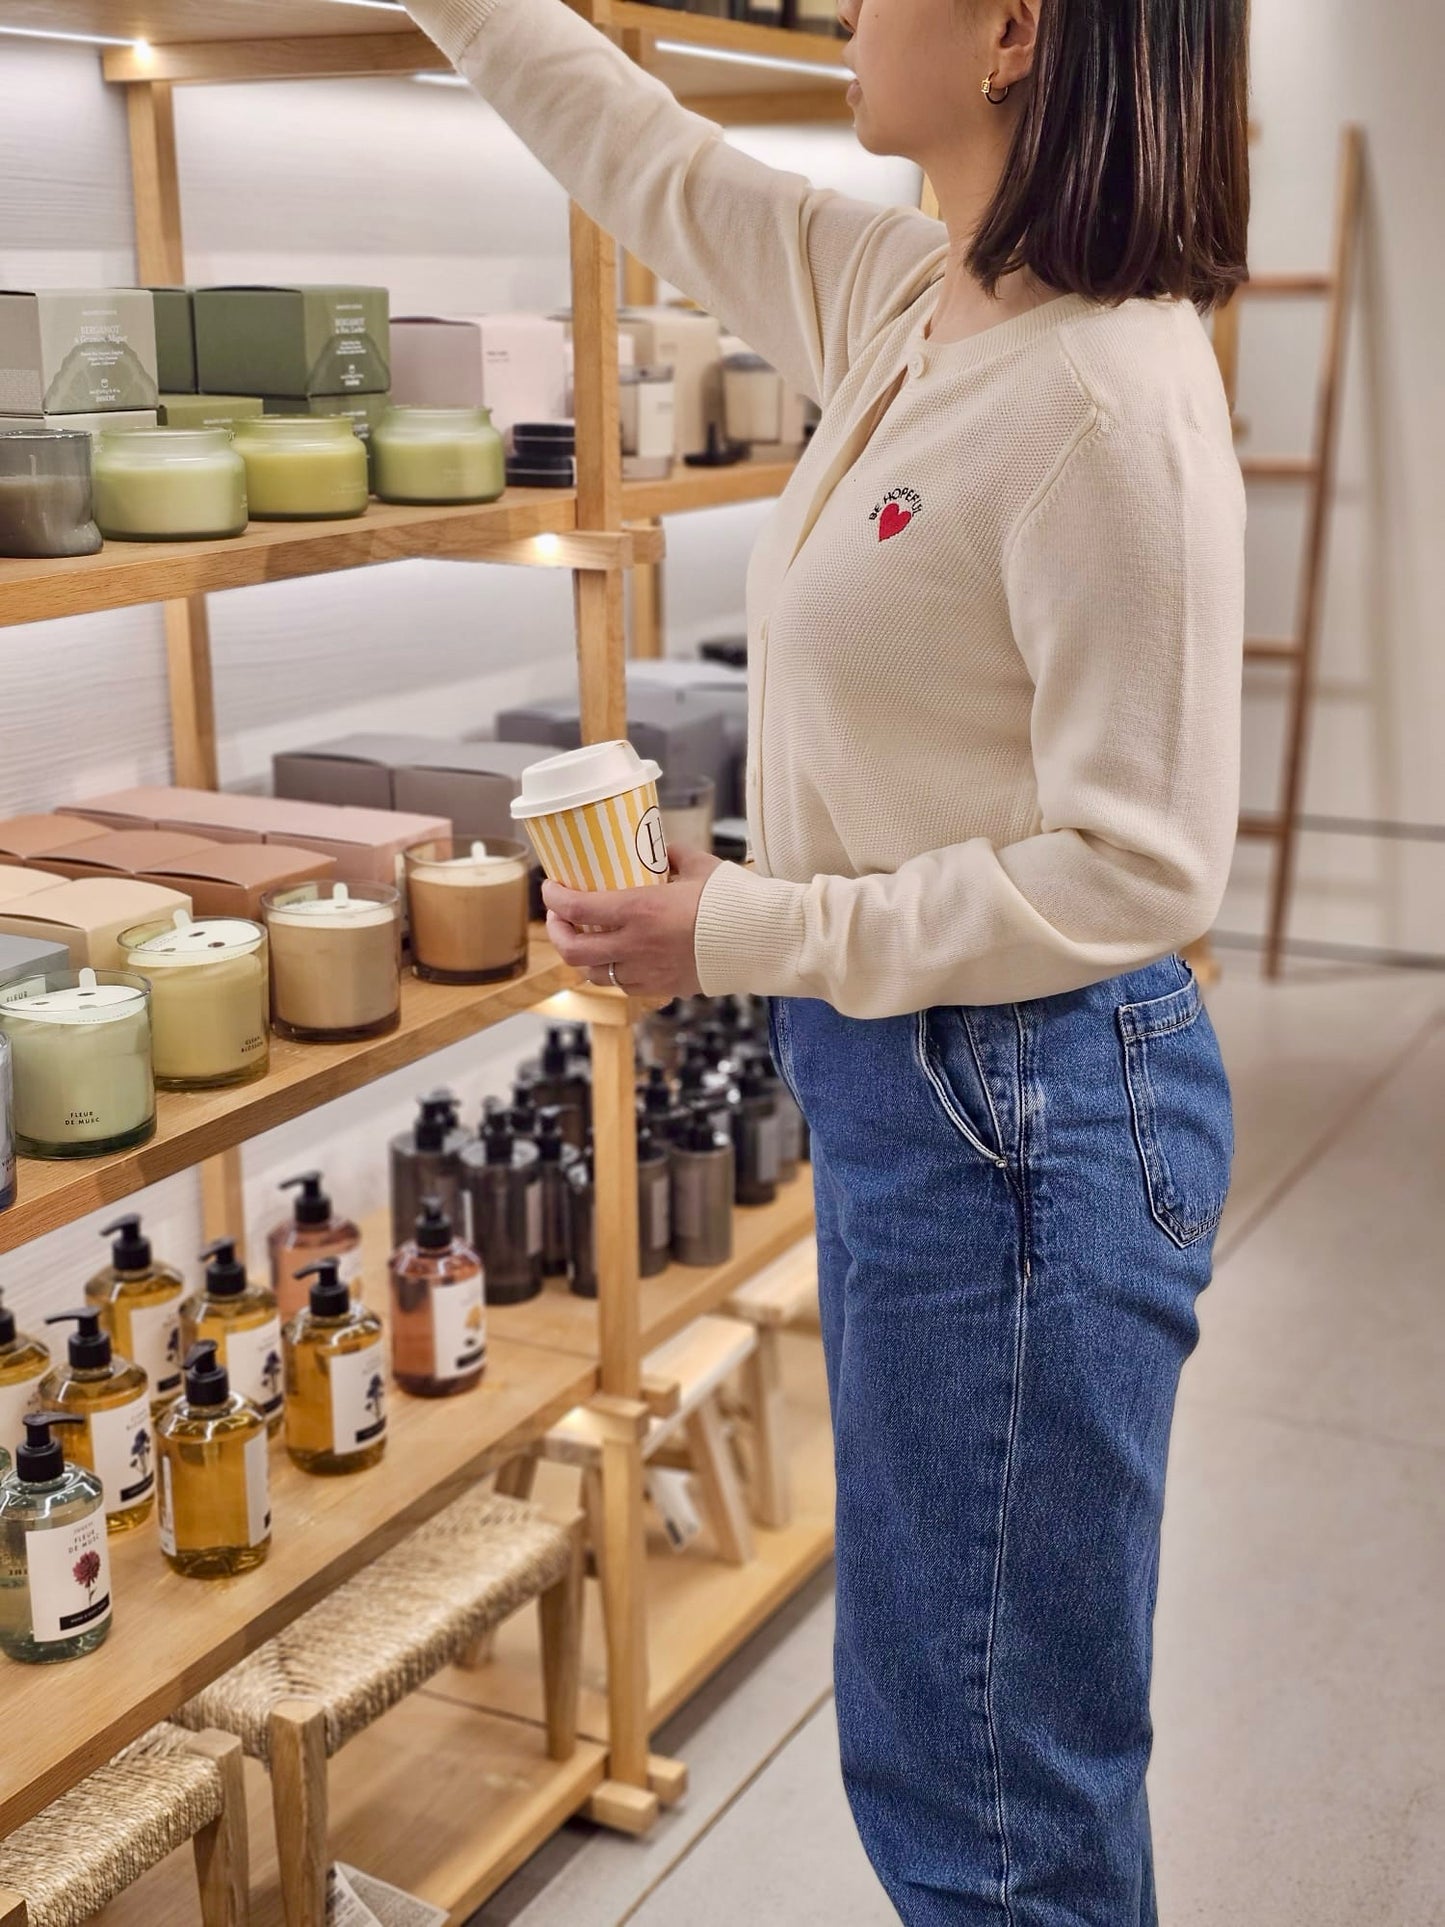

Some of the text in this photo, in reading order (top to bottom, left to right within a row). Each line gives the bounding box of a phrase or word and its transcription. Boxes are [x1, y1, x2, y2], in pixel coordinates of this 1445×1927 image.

[869, 487, 922, 520] BE HOPEFUL
[74, 1529, 95, 1545] FLEUR
